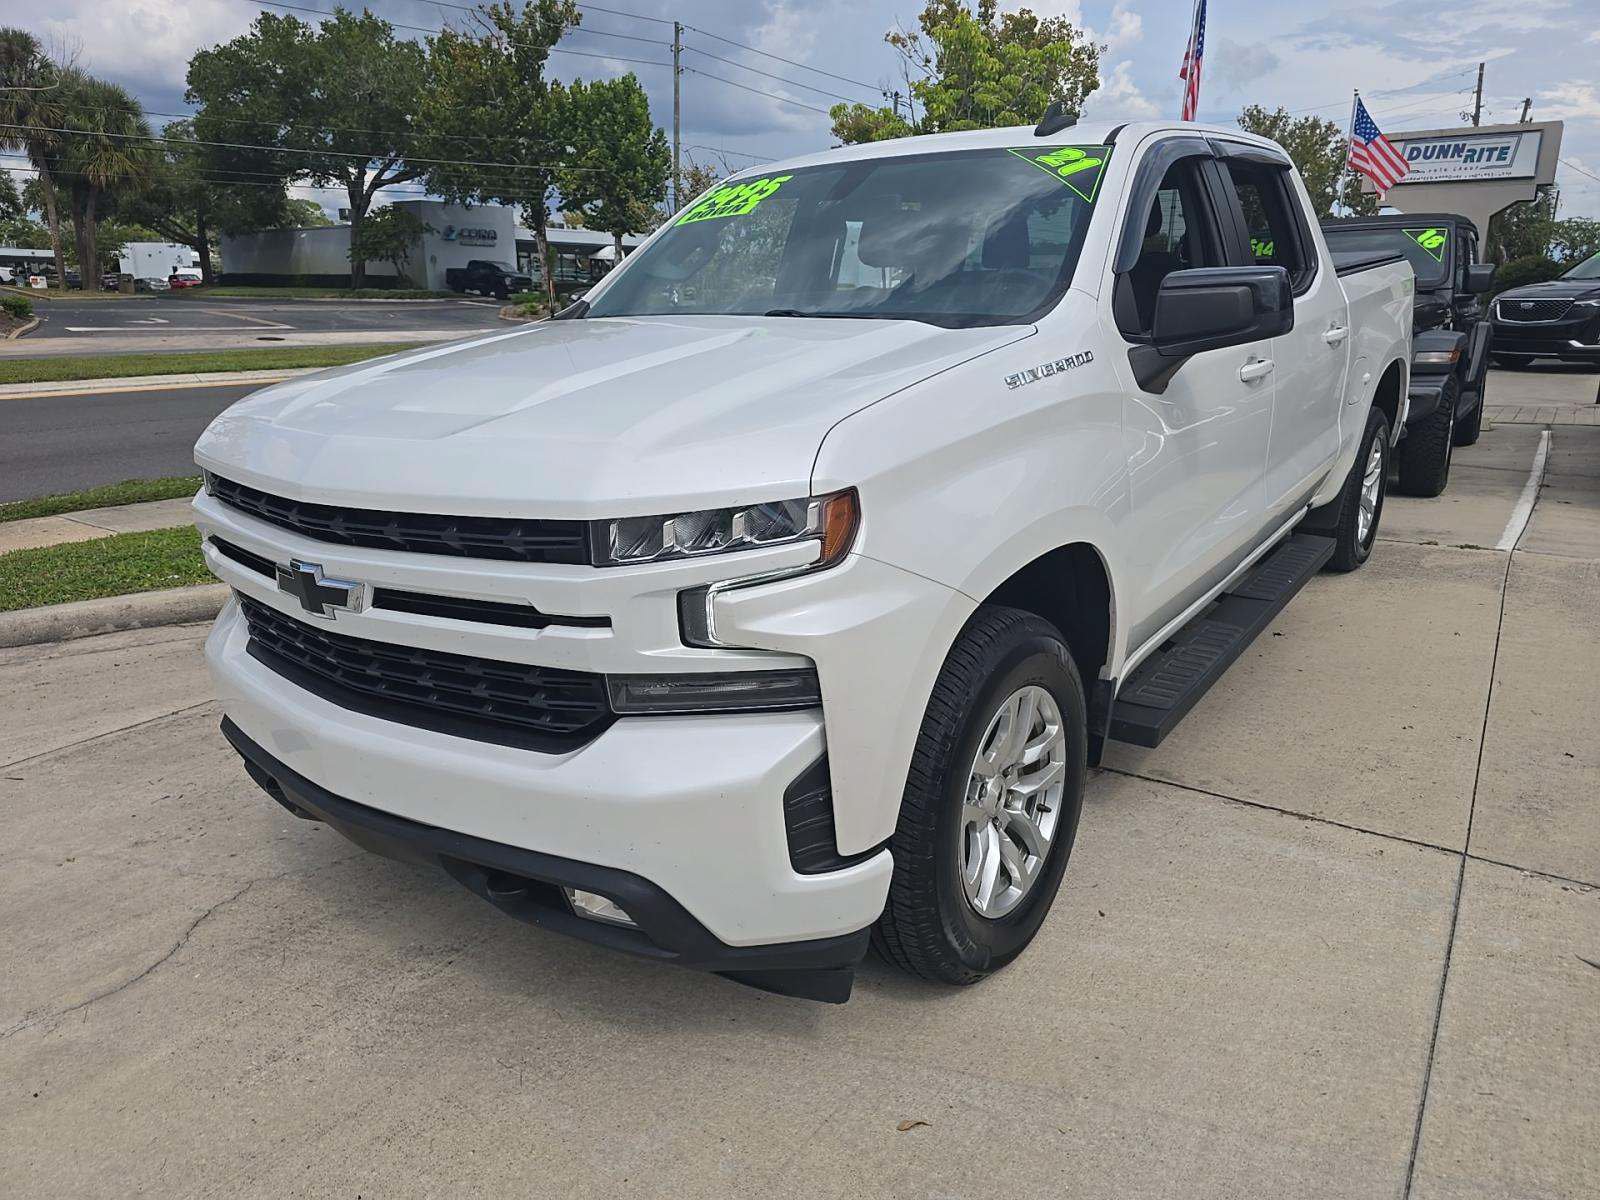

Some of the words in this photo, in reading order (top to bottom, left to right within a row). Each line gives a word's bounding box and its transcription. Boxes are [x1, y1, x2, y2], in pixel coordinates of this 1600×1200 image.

[1035, 147, 1102, 177] 21
[1407, 143, 1466, 162] DUNN
[1463, 145, 1511, 164] RITE
[1004, 350, 1094, 390] SILVERADO
